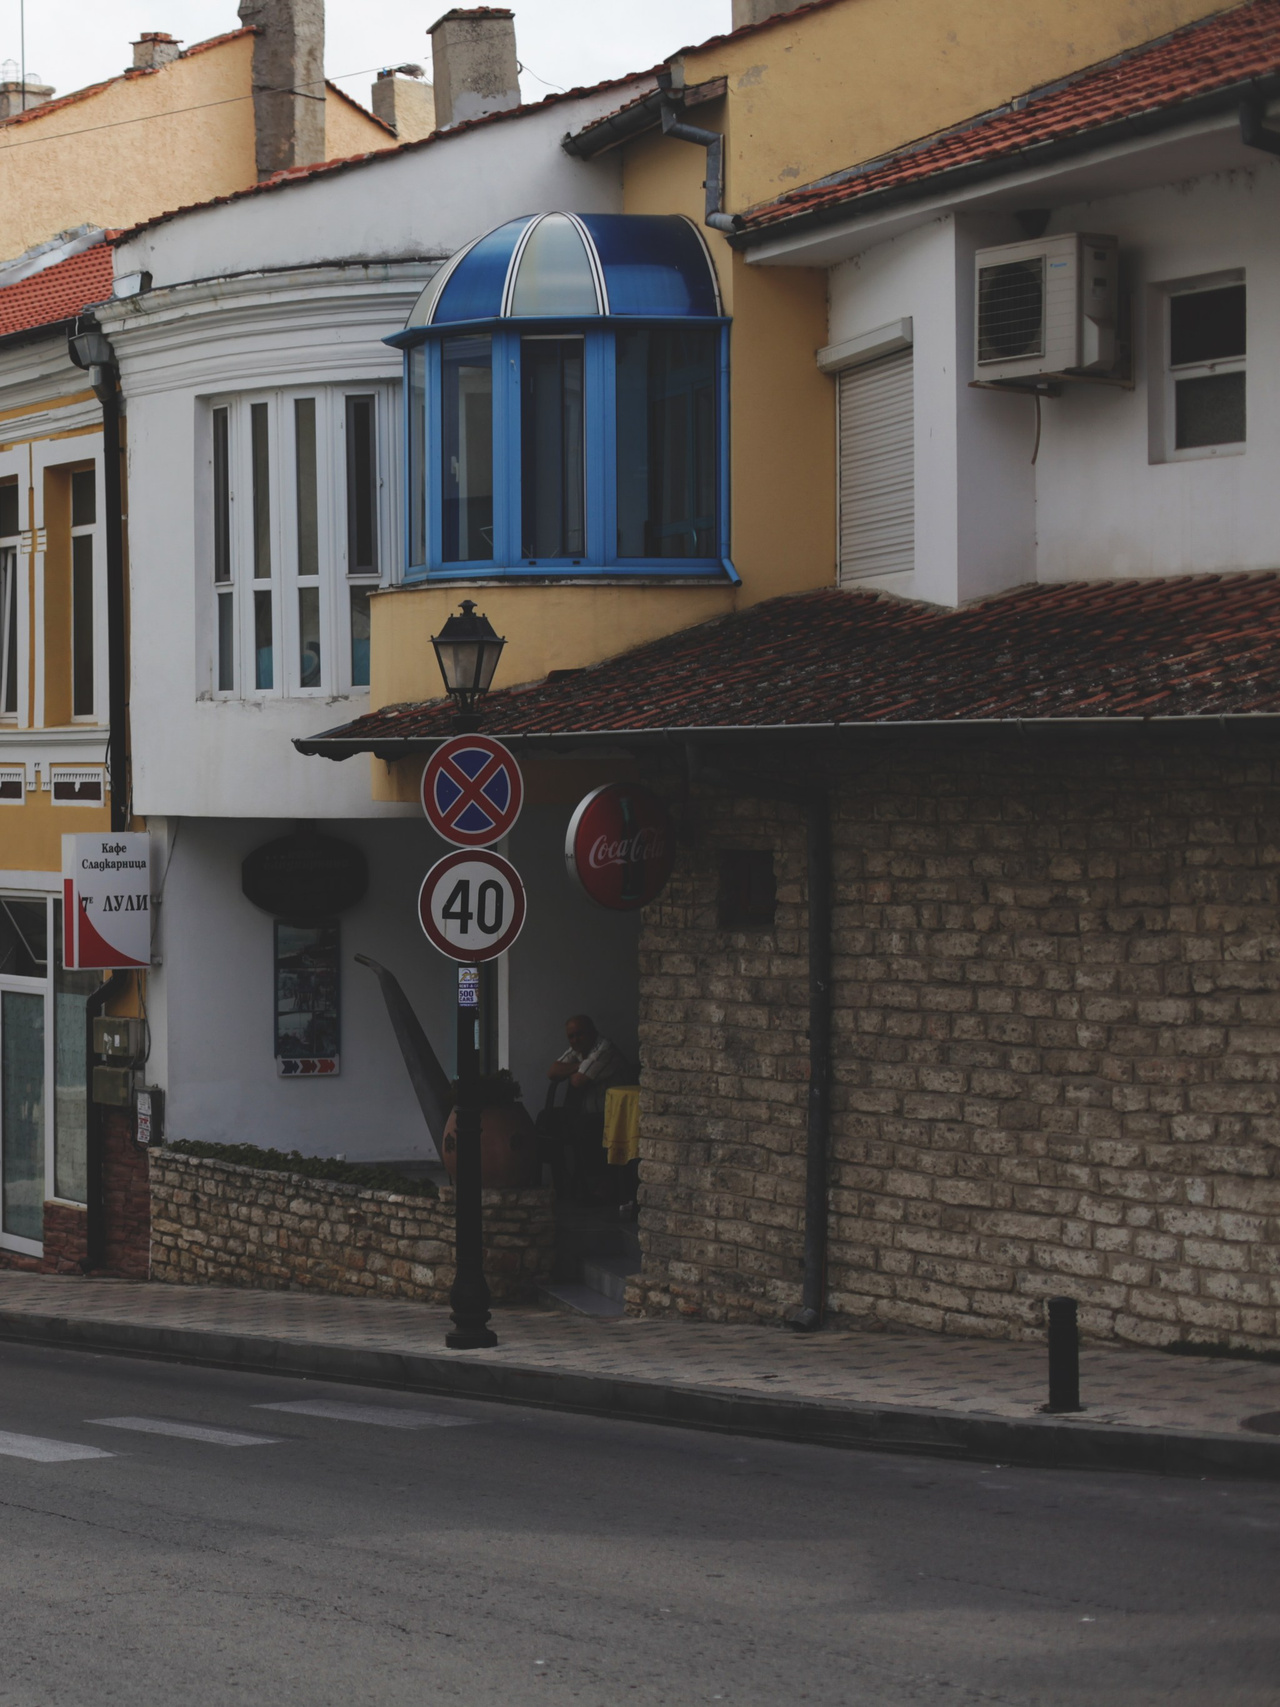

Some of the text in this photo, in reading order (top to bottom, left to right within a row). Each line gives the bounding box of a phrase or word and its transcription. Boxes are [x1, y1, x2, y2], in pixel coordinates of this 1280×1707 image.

[101, 843, 127, 855] Кафе
[589, 827, 665, 869] Coca-Cola
[81, 858, 147, 871] Сладкарница
[103, 894, 149, 912] ЛУЛИ
[442, 879, 504, 935] 40
[459, 990, 474, 998] 500
